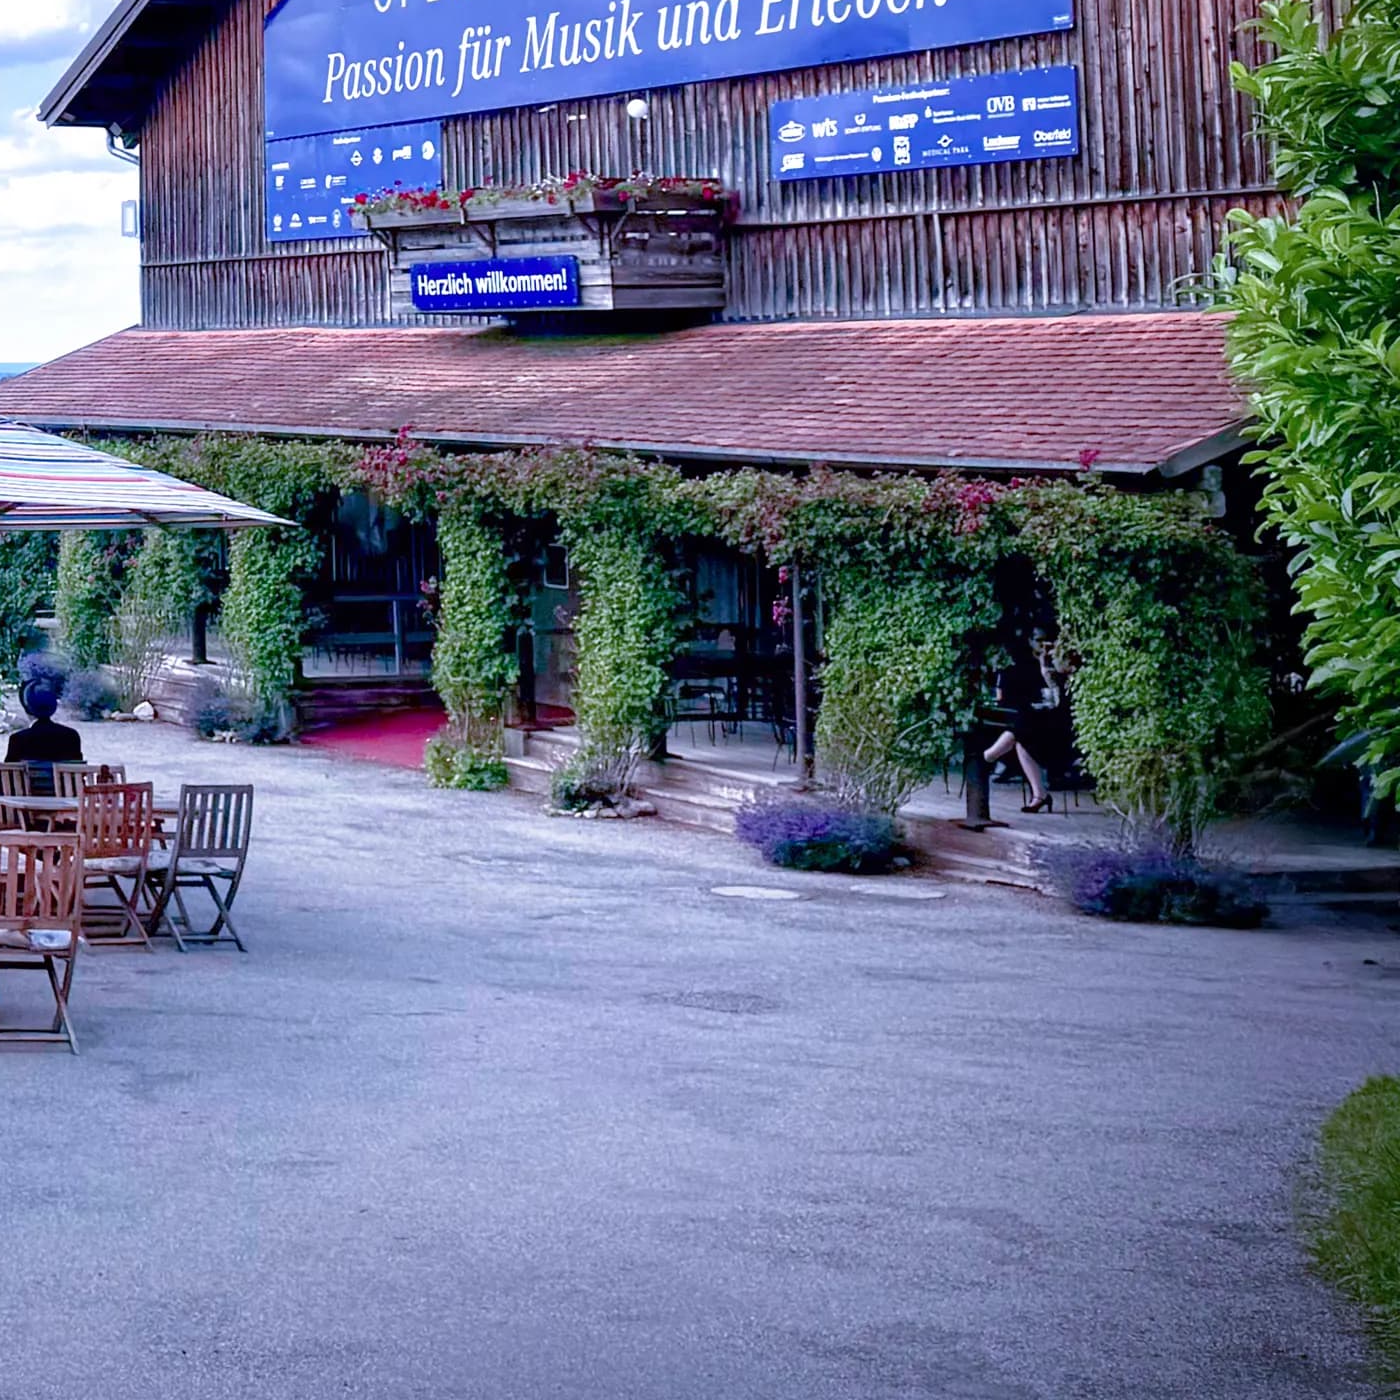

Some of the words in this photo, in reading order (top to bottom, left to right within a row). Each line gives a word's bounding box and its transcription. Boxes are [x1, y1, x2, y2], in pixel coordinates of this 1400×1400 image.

[322, 41, 445, 104] Passion
[451, 25, 512, 97] für
[986, 95, 1016, 113] OVB
[417, 273, 473, 296] Herzlich
[475, 268, 568, 294] willkommen!
